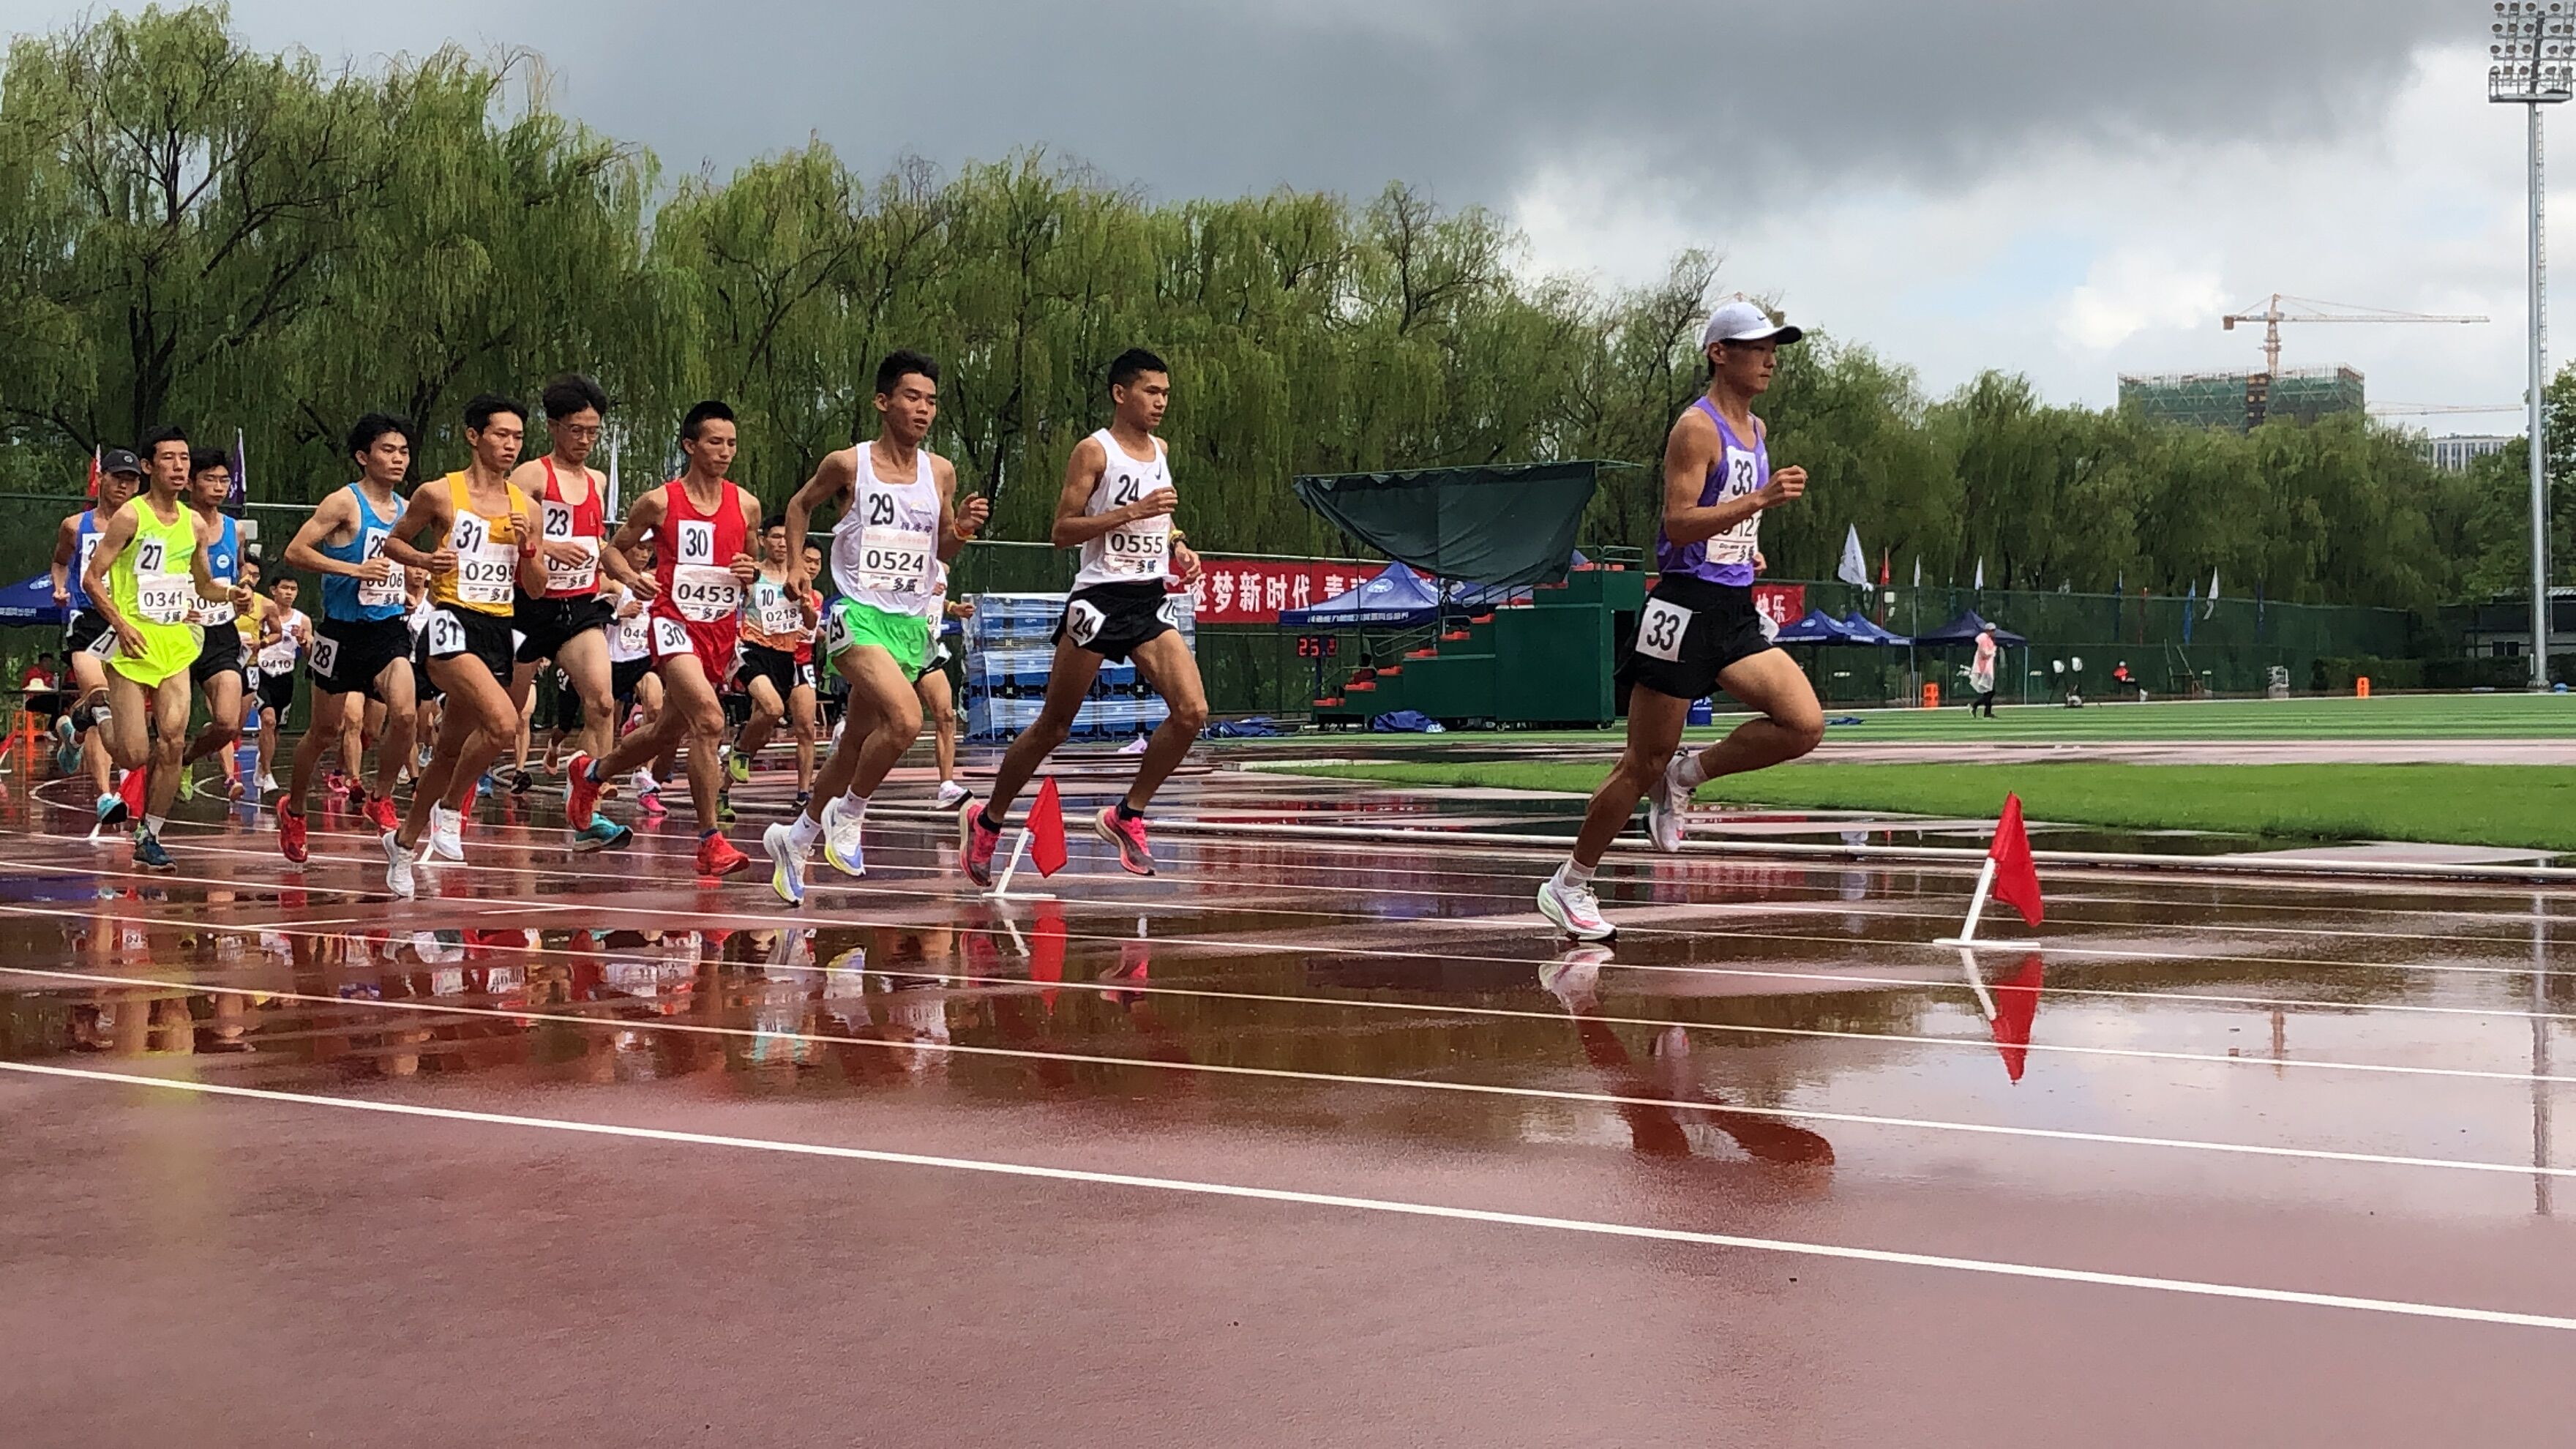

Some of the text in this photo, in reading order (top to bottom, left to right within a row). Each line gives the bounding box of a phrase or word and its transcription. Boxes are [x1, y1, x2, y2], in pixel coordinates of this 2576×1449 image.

[1115, 474, 1139, 506] 24
[1732, 459, 1753, 495] 33
[545, 508, 569, 536] 23
[869, 493, 894, 525] 29
[456, 520, 482, 553] 31
[685, 528, 708, 557] 30
[1111, 533, 1163, 554] 0555
[141, 544, 162, 570] 27
[866, 550, 924, 572] 0524
[143, 591, 182, 607] 0341
[678, 583, 735, 603] 0453
[761, 589, 774, 606] 10
[1185, 571, 1310, 613] 逐梦新时代
[766, 608, 797, 622] 0218
[1072, 607, 1096, 642] 24
[435, 617, 459, 646] 31
[662, 623, 686, 647] 30
[1646, 610, 1680, 651] 33
[262, 659, 291, 669] 0410
[315, 641, 332, 669] 28
